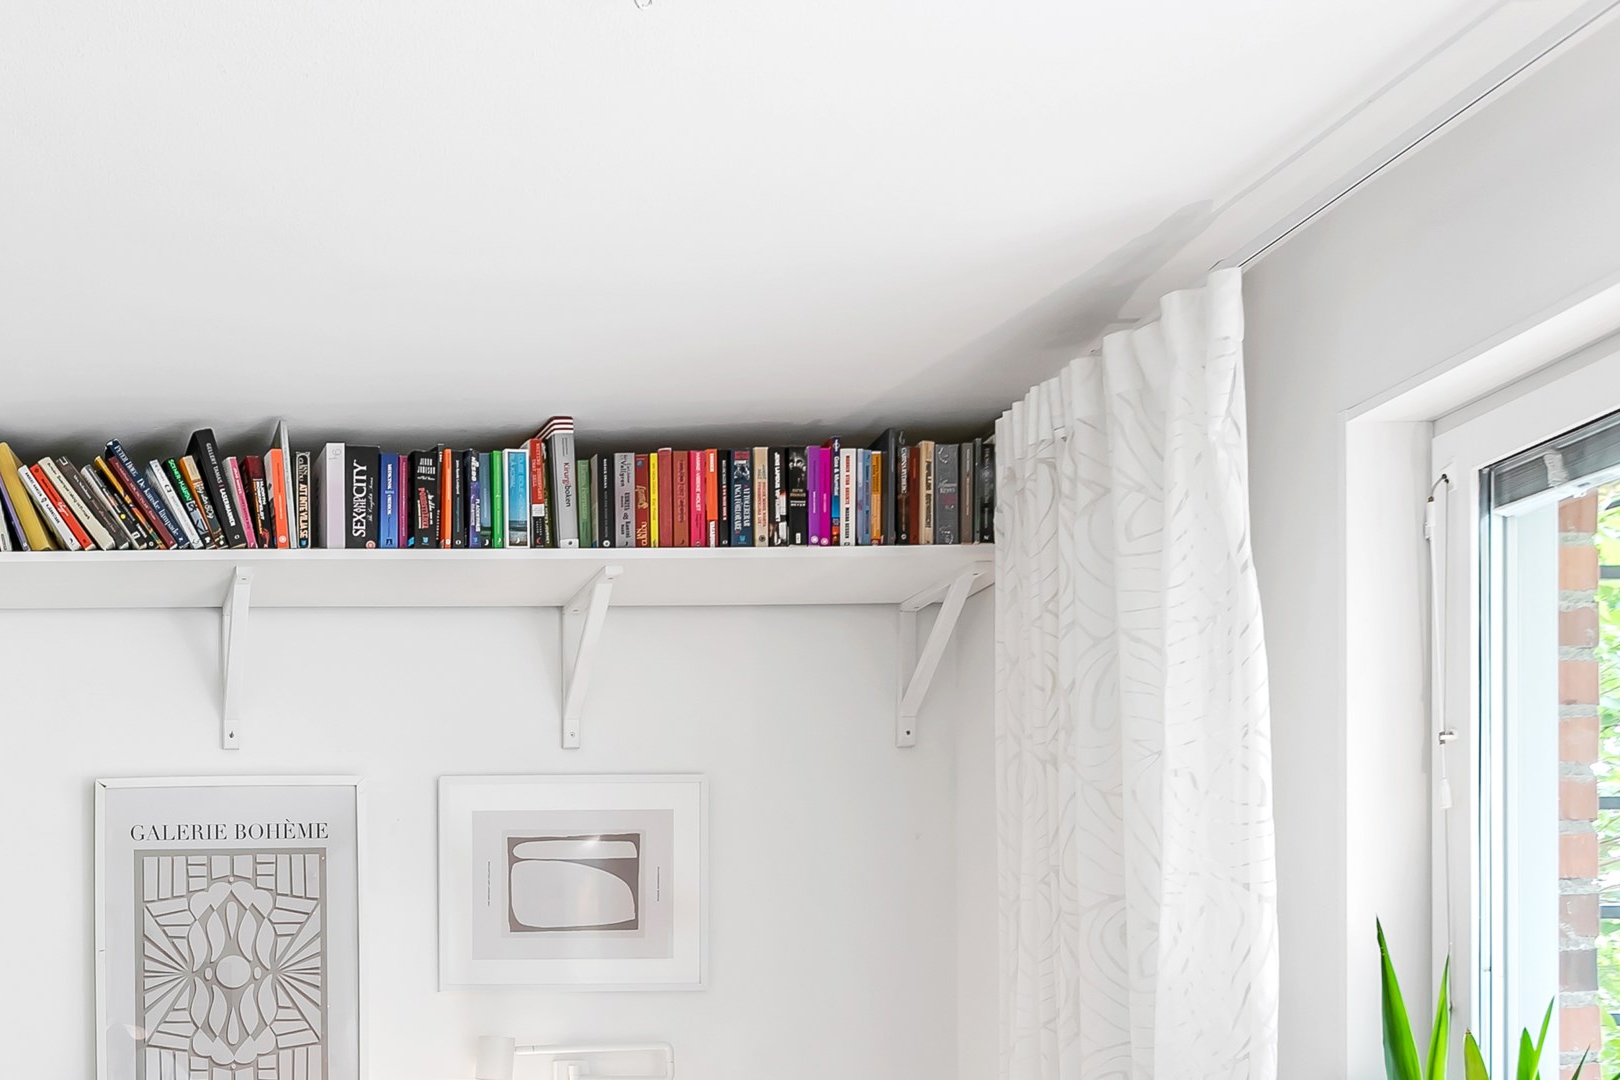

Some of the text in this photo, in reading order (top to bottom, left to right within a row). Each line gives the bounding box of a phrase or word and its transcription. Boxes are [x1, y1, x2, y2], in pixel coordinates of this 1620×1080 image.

[114, 445, 129, 464] PETER
[206, 442, 217, 466] GELLERT
[213, 466, 223, 484] TAMAS
[561, 462, 572, 507] Kirurgiboken
[619, 461, 627, 487] Vallgren
[299, 483, 308, 539] ATT INTE VILJA SE
[352, 512, 366, 538] SEX
[130, 818, 329, 841] GALERIE BOHÈME
